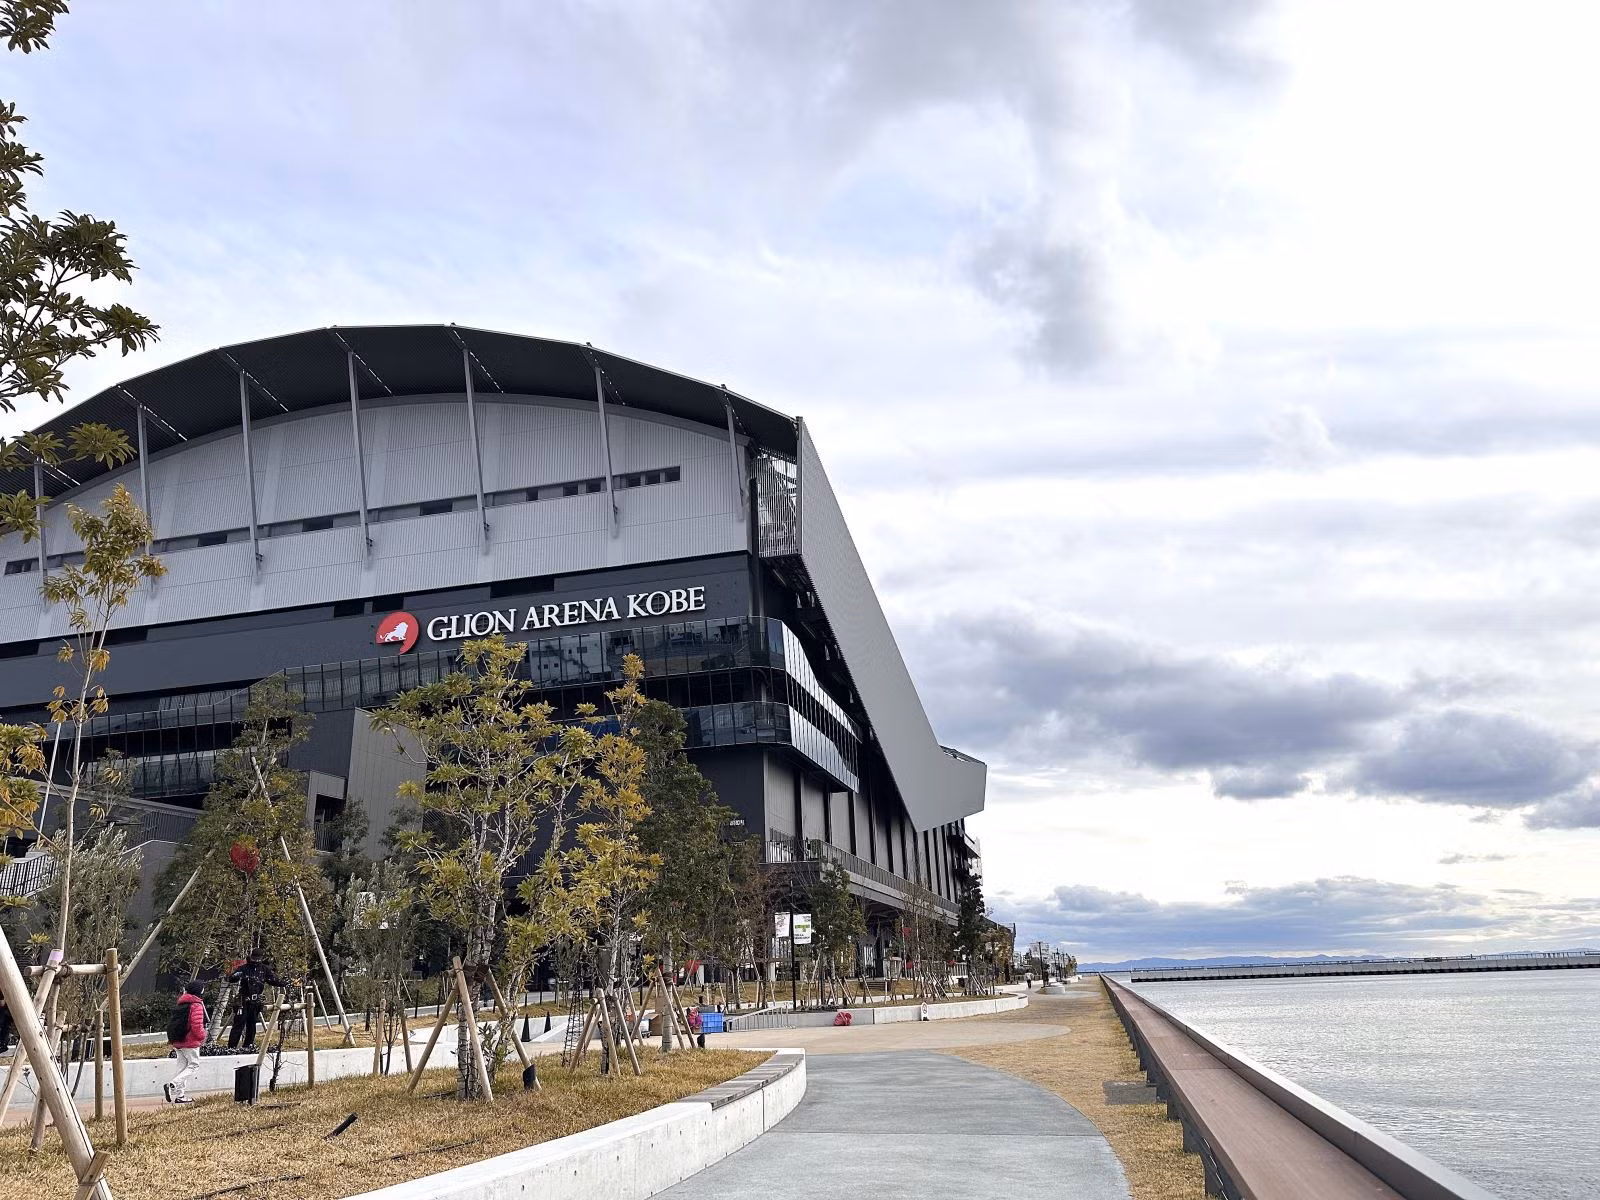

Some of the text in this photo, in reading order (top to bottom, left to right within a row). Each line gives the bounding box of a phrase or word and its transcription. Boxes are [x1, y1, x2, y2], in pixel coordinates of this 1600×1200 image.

[426, 586, 706, 641] GLION ARENA KOBE
